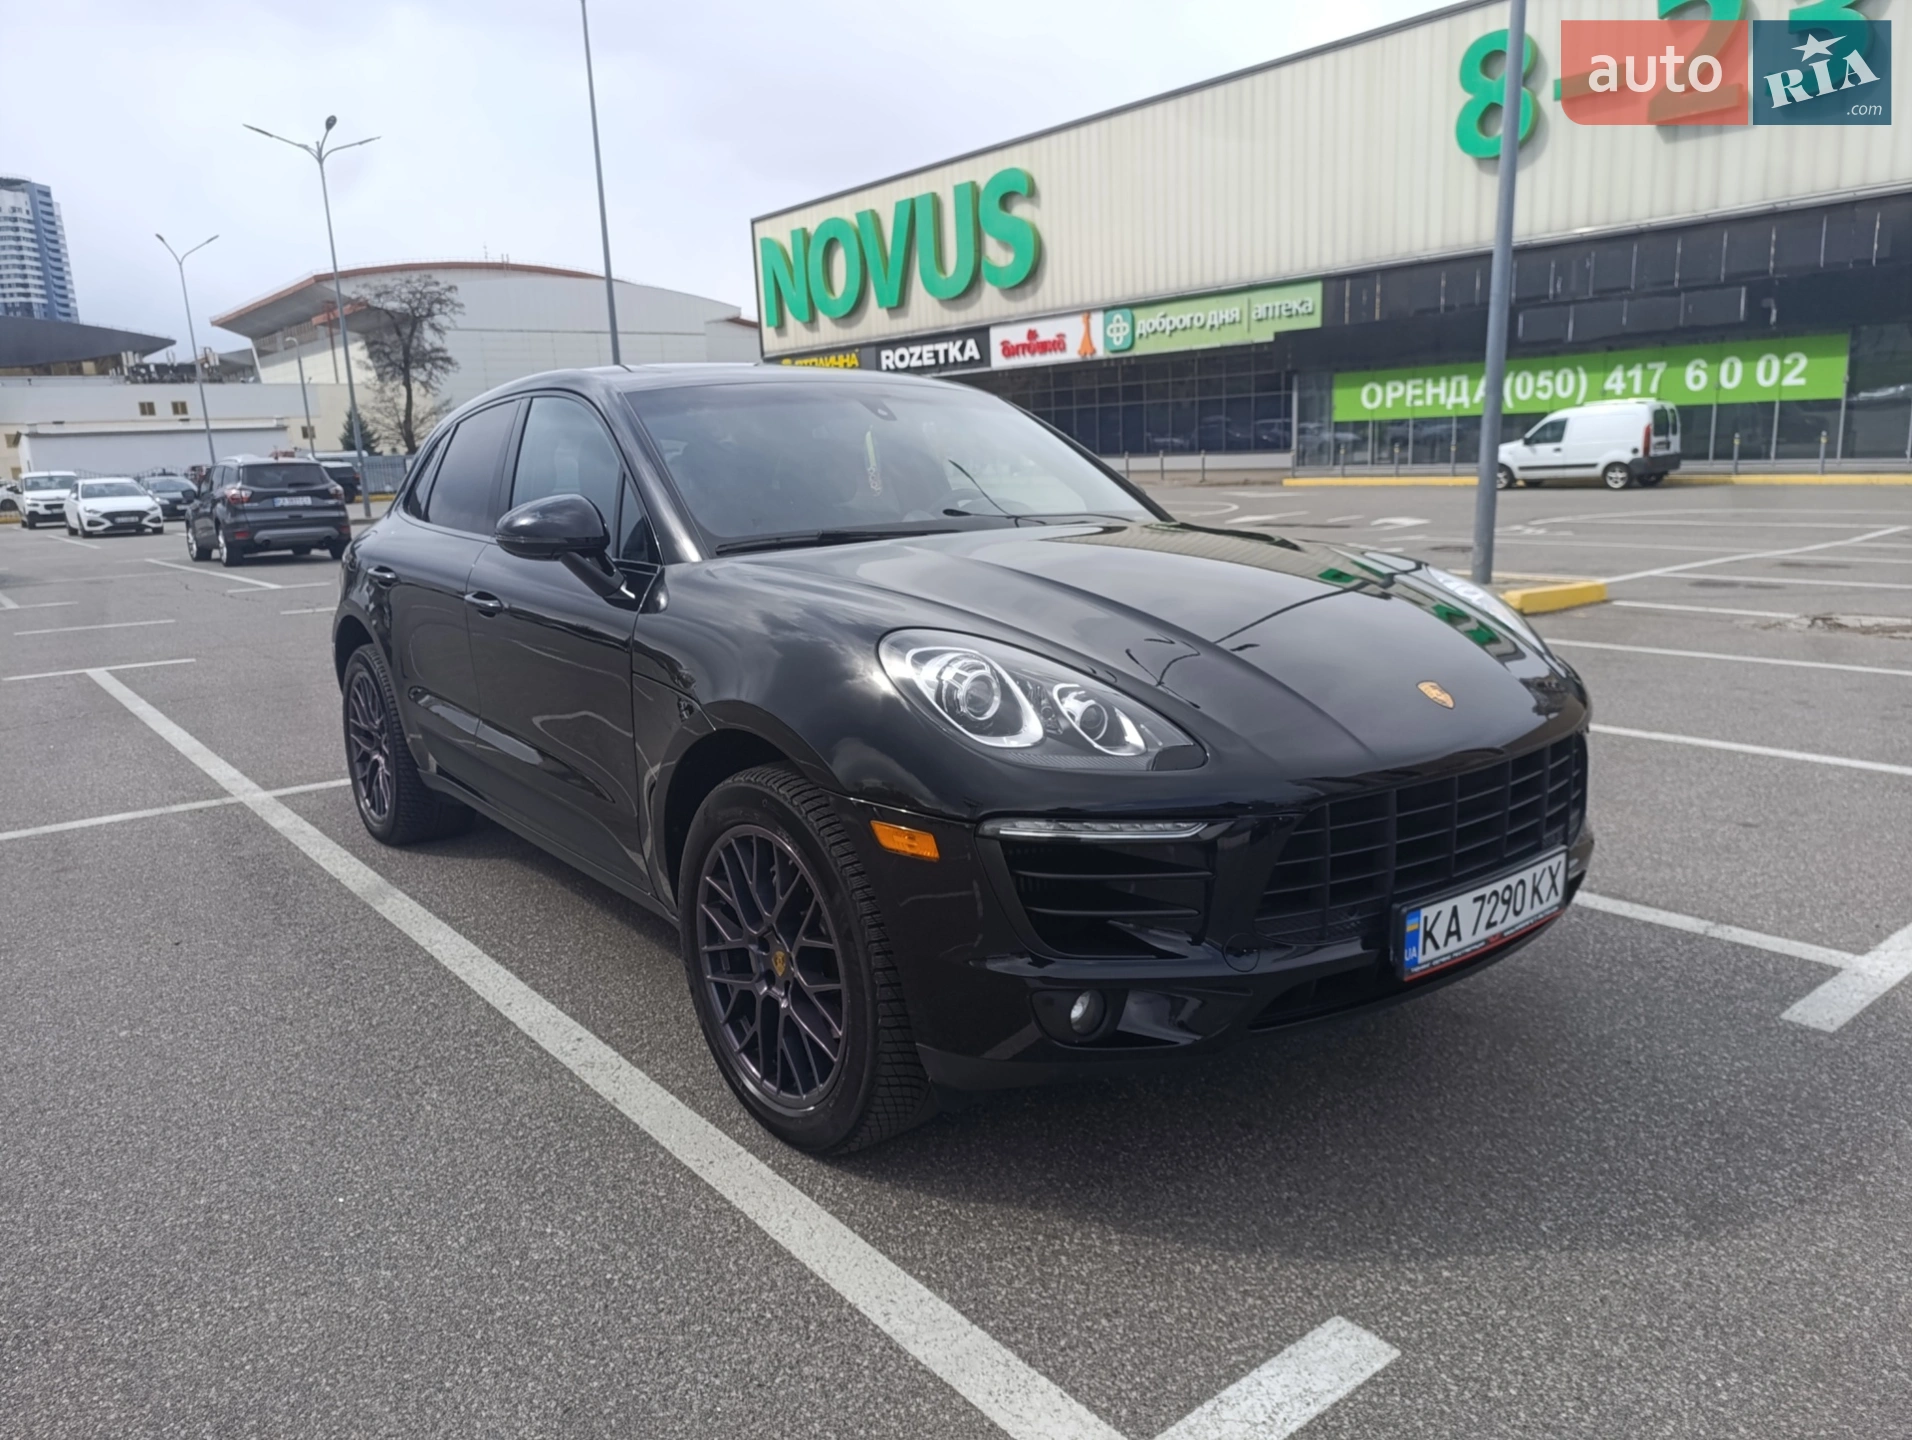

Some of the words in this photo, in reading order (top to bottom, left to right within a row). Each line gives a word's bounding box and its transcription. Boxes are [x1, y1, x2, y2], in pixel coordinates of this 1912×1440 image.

[760, 167, 1041, 327] NOVUS
[1136, 312, 1206, 338] доброго
[1206, 307, 1240, 328] дня
[1253, 298, 1313, 321] аптека
[881, 338, 980, 370] ROZETKA
[1503, 365, 1588, 408] (050)
[1603, 361, 1667, 395] 417
[1422, 905, 1462, 956] KA
[1472, 878, 1527, 936] 7290
[1530, 860, 1562, 910] KX
[1405, 946, 1418, 961] UA
